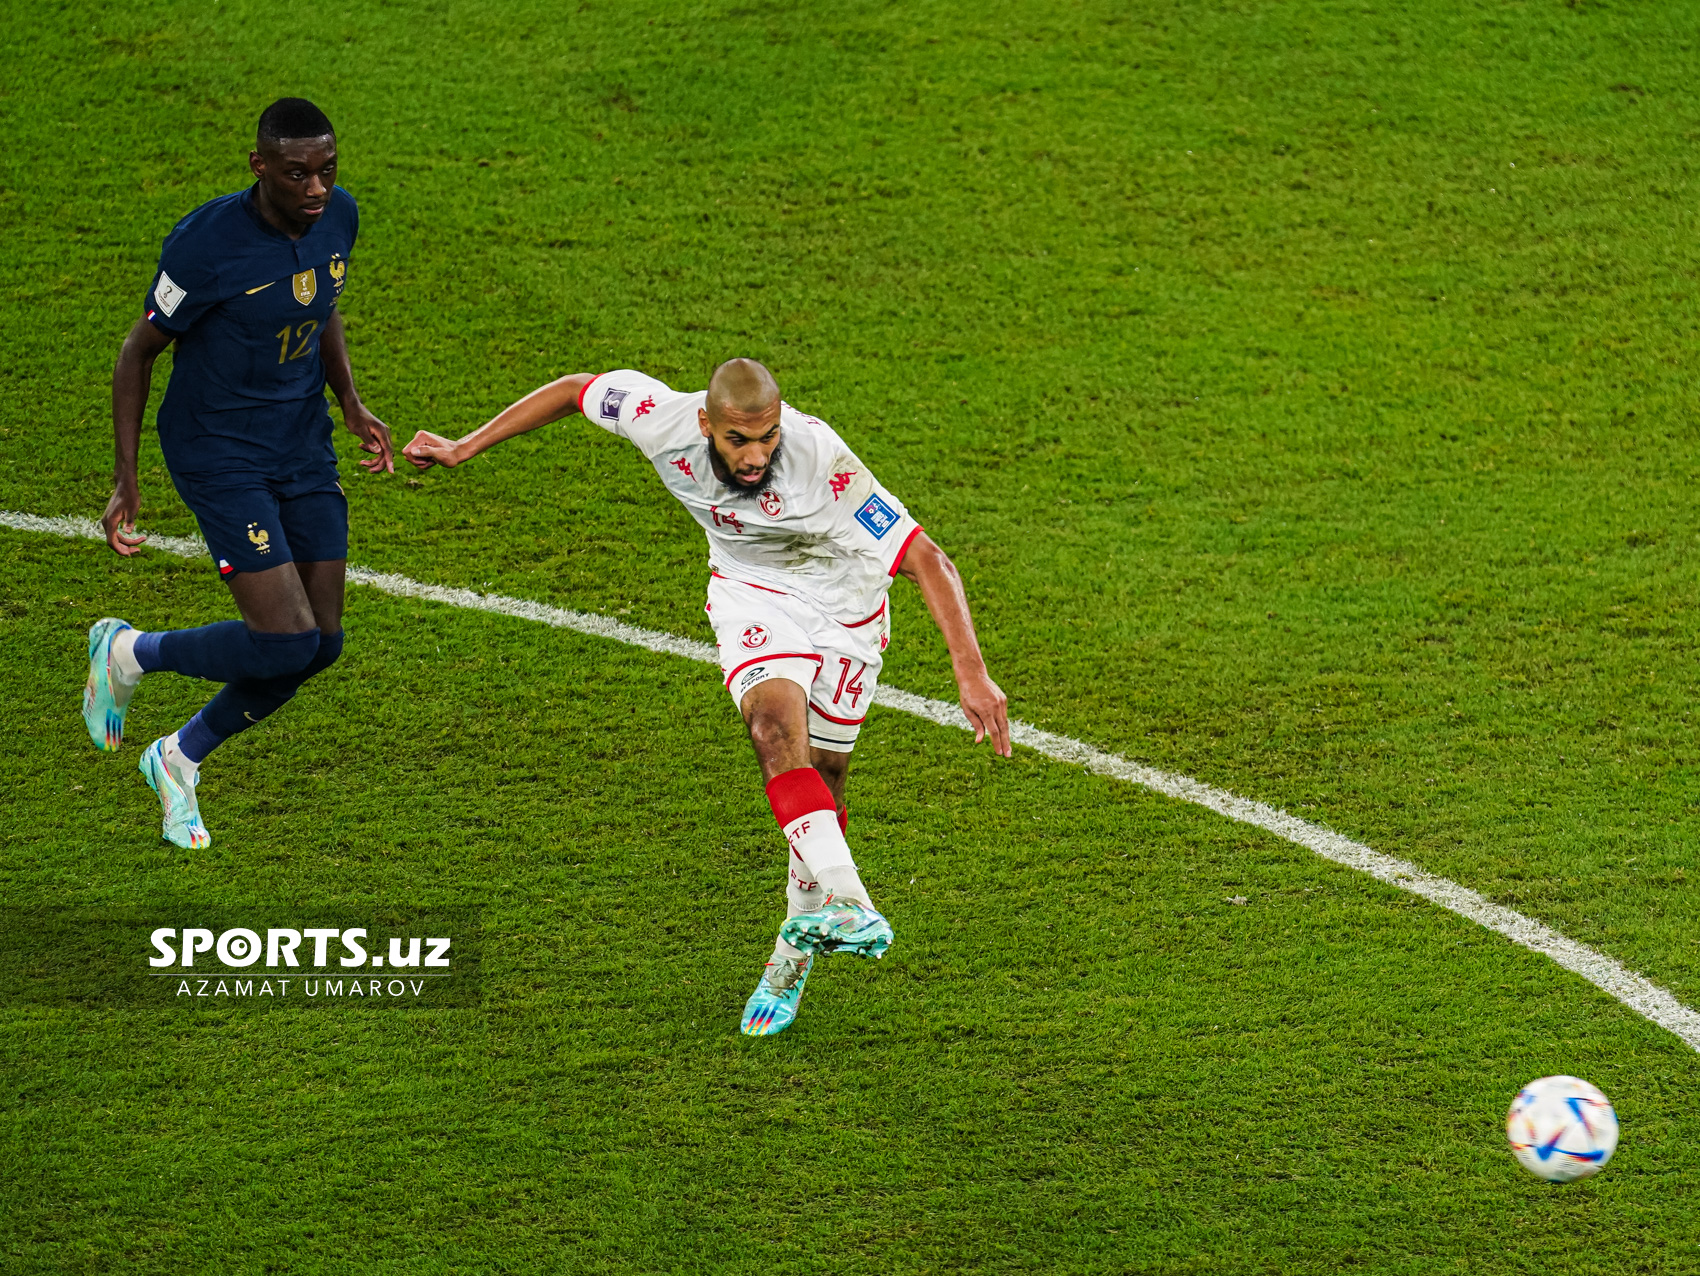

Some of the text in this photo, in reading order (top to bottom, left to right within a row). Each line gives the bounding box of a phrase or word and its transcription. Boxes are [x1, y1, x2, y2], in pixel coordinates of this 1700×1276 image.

[276, 320, 318, 364] 12
[710, 505, 744, 534] 14
[832, 657, 867, 709] 14
